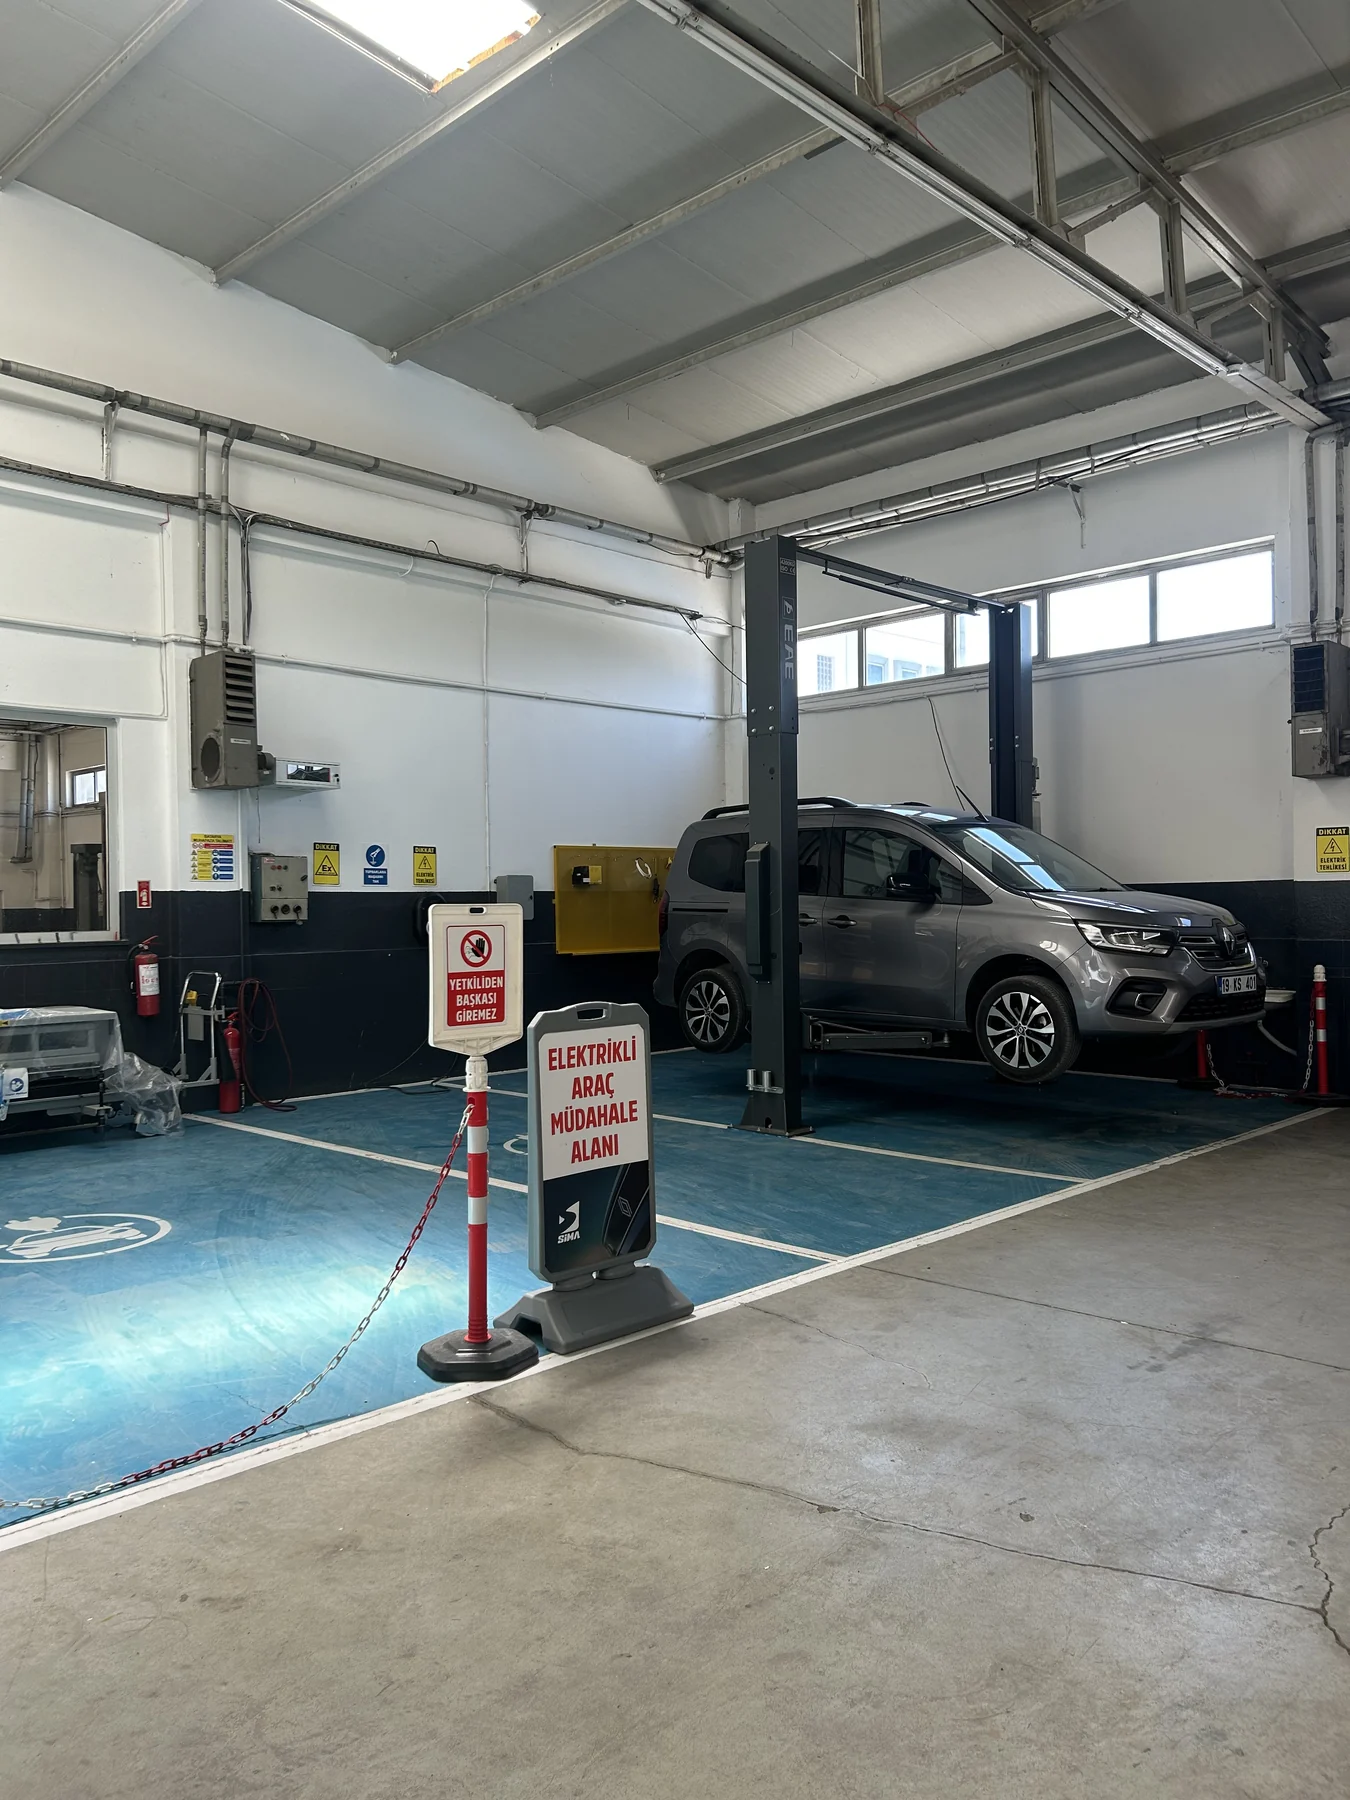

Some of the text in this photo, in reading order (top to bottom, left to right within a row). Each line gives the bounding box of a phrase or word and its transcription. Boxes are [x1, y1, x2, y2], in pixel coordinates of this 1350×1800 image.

[784, 623, 794, 680] EAE
[322, 864, 332, 872] Ex
[1319, 863, 1347, 871] TEHLİKESİ
[1320, 856, 1347, 864] ELEKTRİK
[449, 975, 504, 991] YETKİLİDEN
[1222, 975, 1256, 993] 19 KS 401
[456, 992, 497, 1008] BAŞKASI
[456, 1008, 497, 1023] GİREMEZ
[548, 1035, 637, 1071] ELEKTRİKLİ
[571, 1072, 615, 1099] ARAÇ
[550, 1099, 639, 1136] MÜDAHALE
[571, 1133, 619, 1164] ALANI
